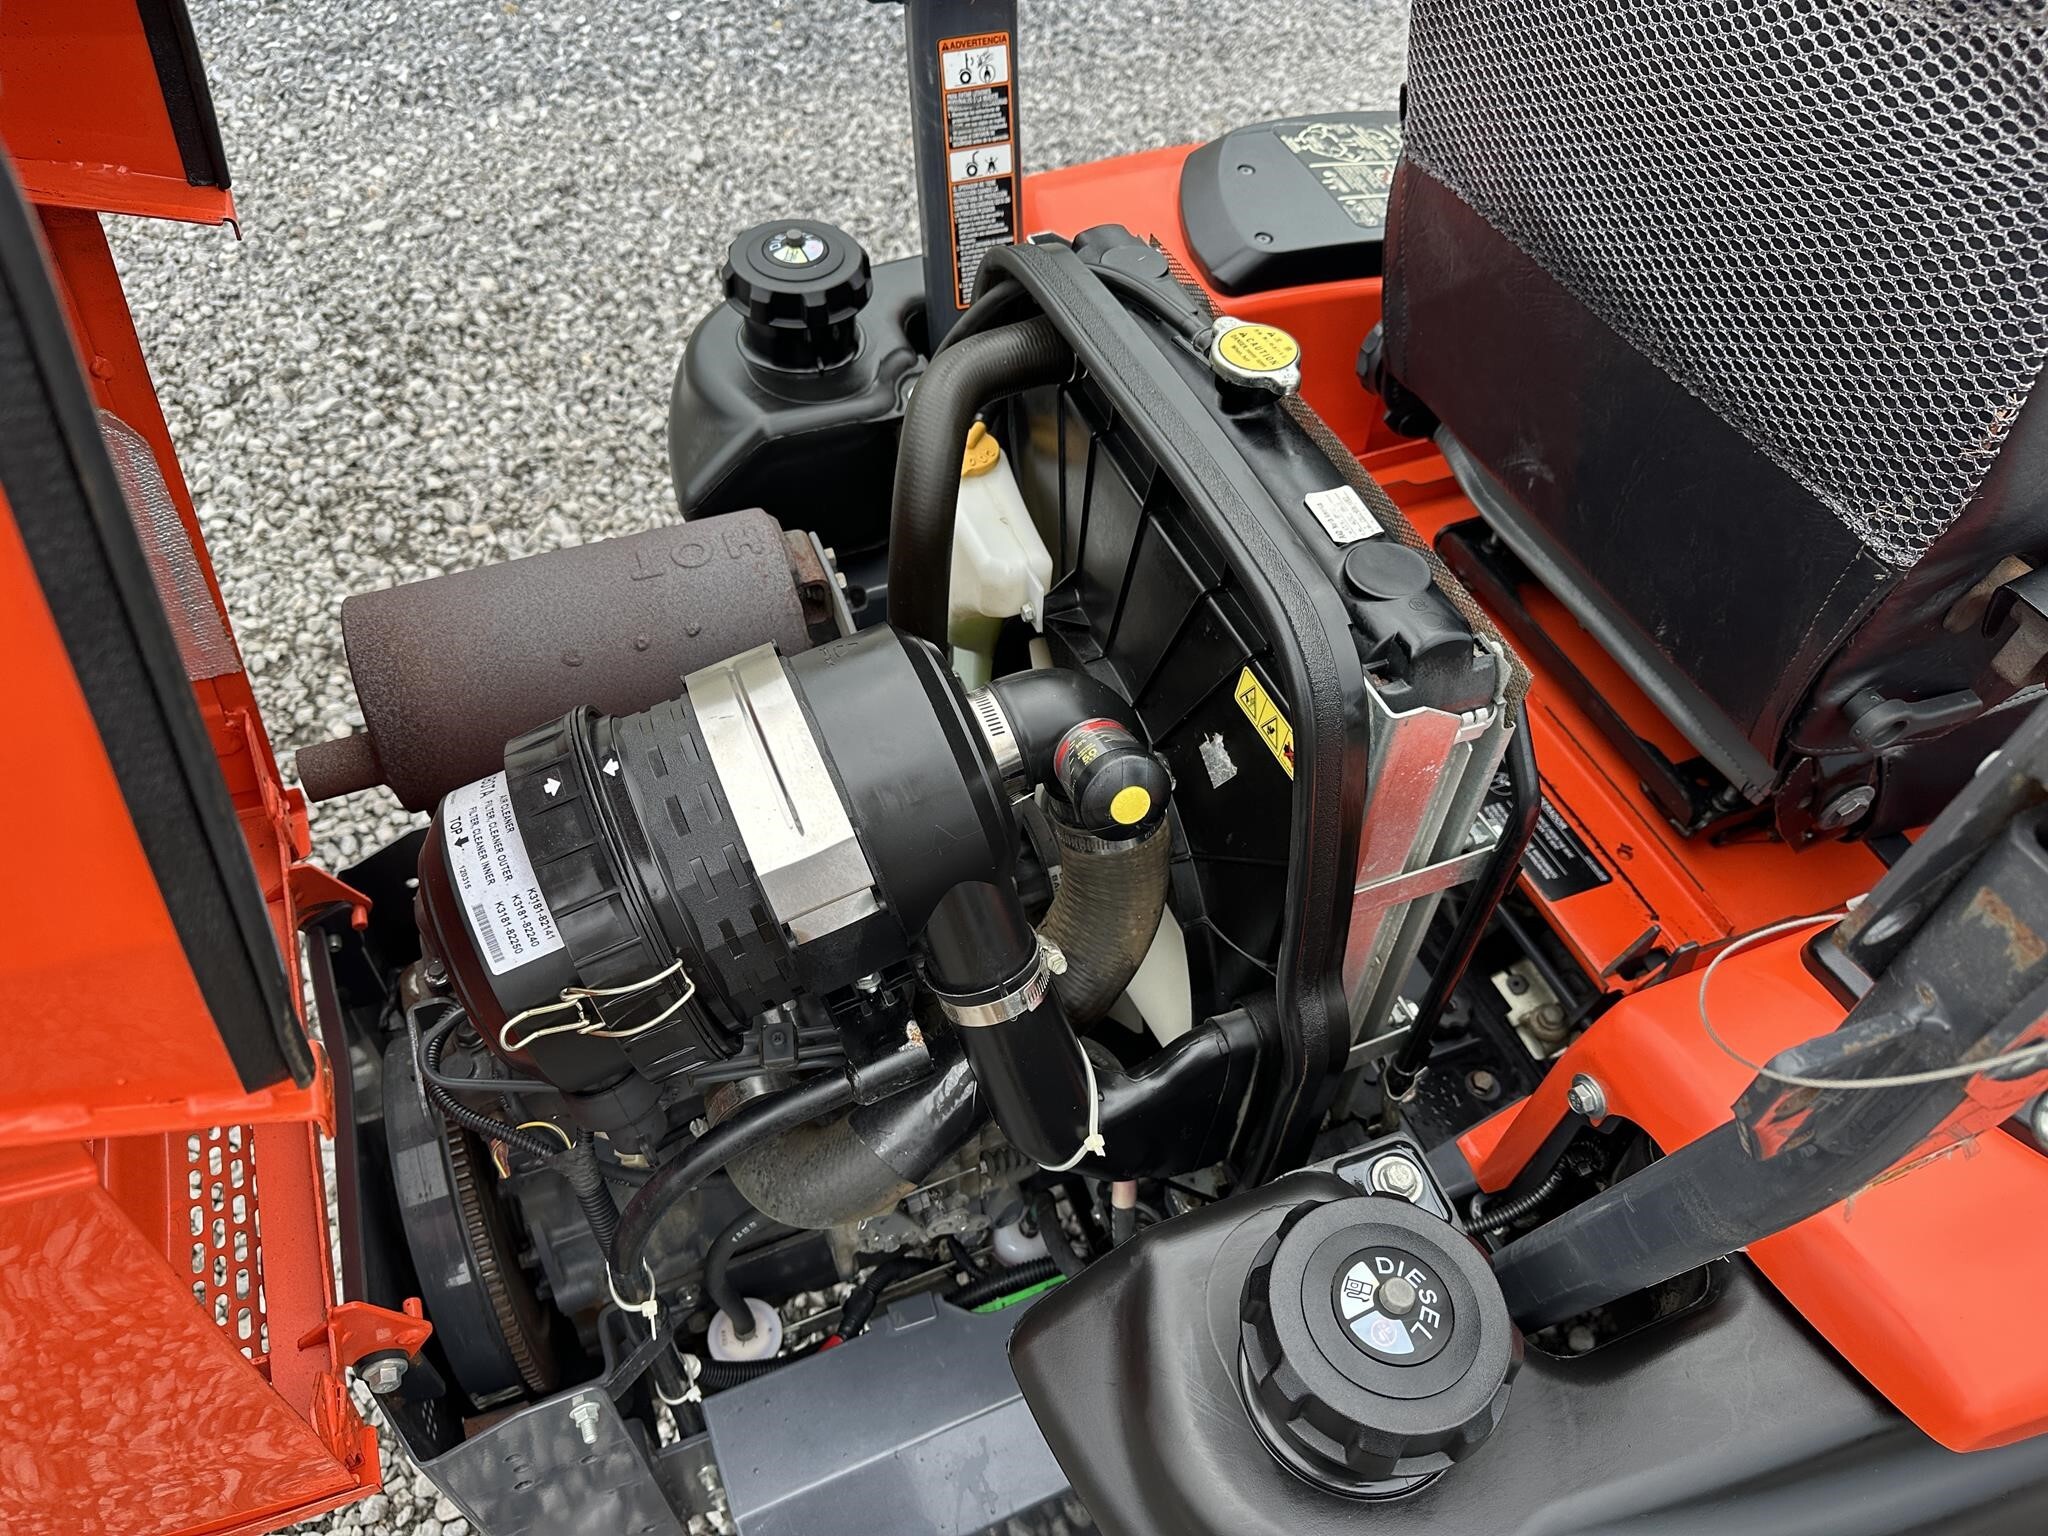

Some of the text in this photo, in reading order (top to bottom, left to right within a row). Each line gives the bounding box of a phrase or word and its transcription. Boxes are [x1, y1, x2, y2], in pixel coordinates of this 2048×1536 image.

[950, 35, 1007, 50] ADVERTENCIA
[1246, 338, 1277, 365] CAUTION
[450, 816, 472, 889] TOP 120315
[472, 828, 488, 861] CLEANER
[481, 860, 496, 886] INNER
[494, 900, 524, 955] K3181-82250
[489, 822, 504, 854] CLEANER
[497, 854, 513, 882] OUTER
[512, 894, 540, 947] K3181-82240
[501, 803, 515, 833] CLEANER
[527, 887, 555, 940] K3181-82141
[1375, 1256, 1441, 1341] DIESEL
